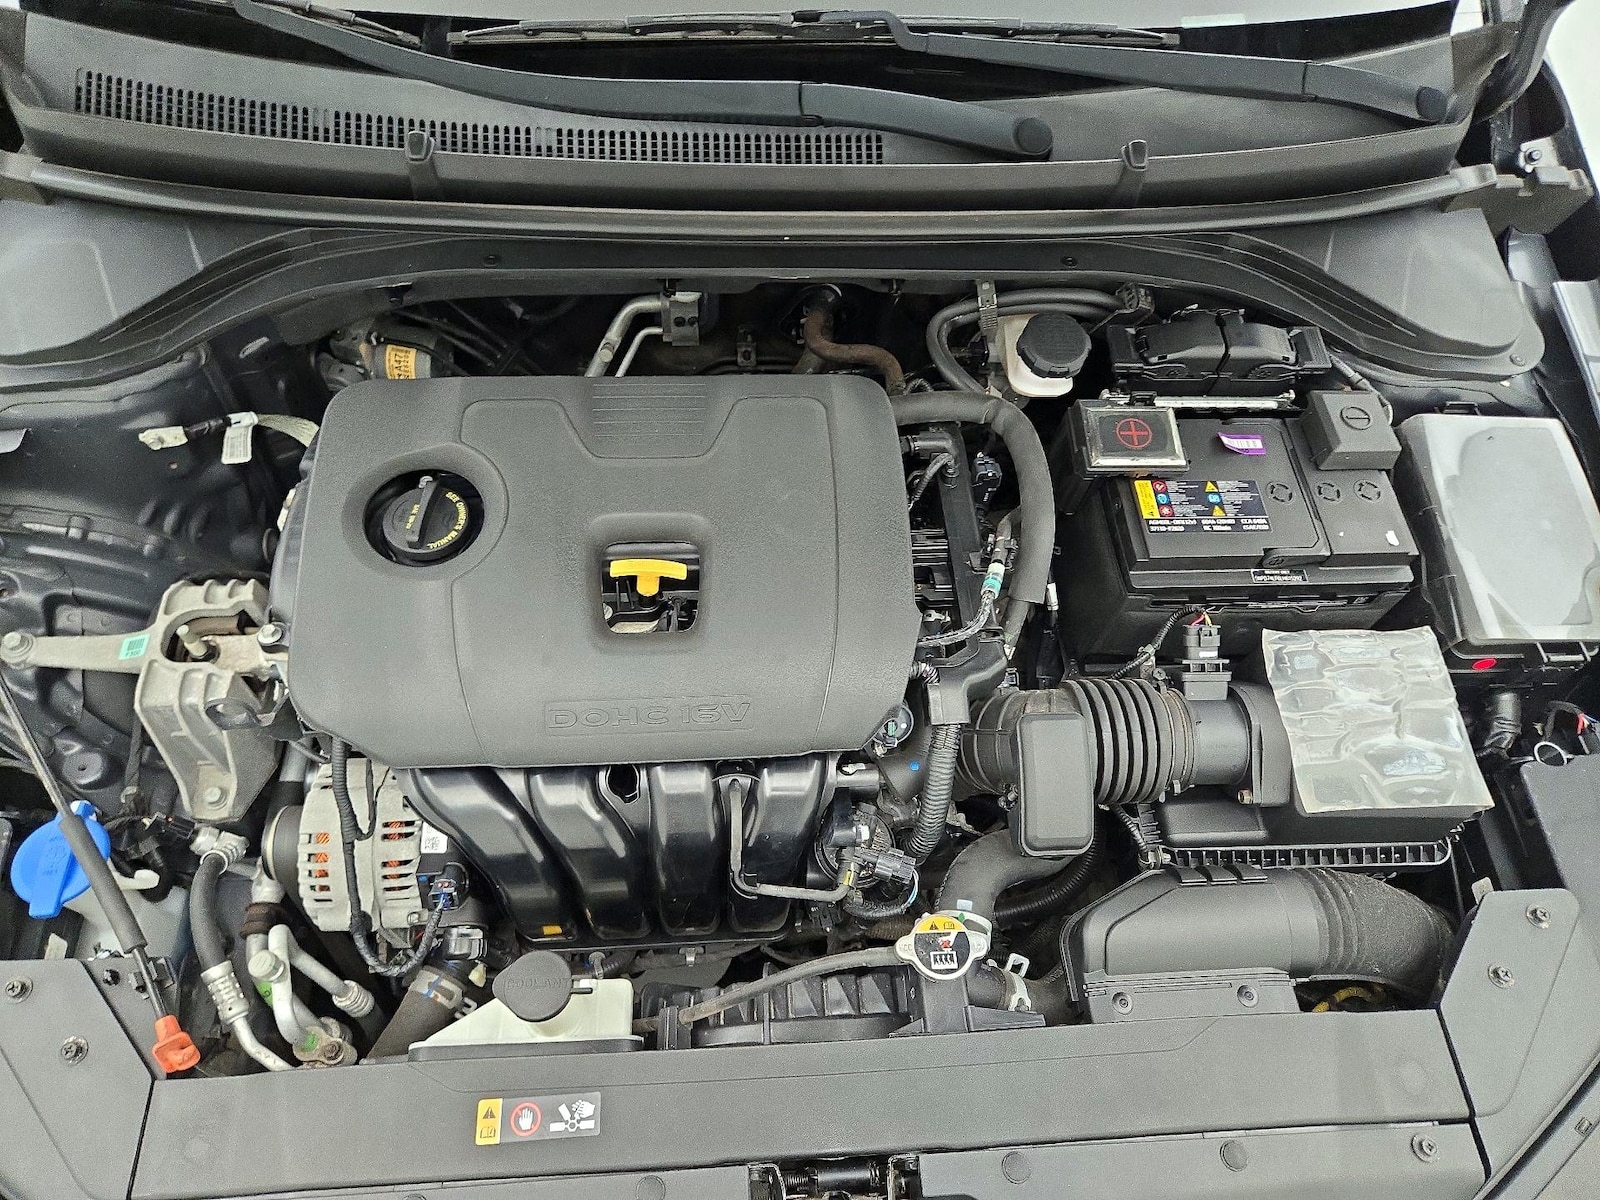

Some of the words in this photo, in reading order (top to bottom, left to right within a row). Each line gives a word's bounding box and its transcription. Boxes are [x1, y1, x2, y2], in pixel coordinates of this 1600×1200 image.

[445, 491, 461, 503] SEE
[454, 502, 467, 530] OWNER'S
[426, 530, 459, 549] MANUAL
[548, 706, 670, 729] DOHC
[680, 702, 751, 725] 16V
